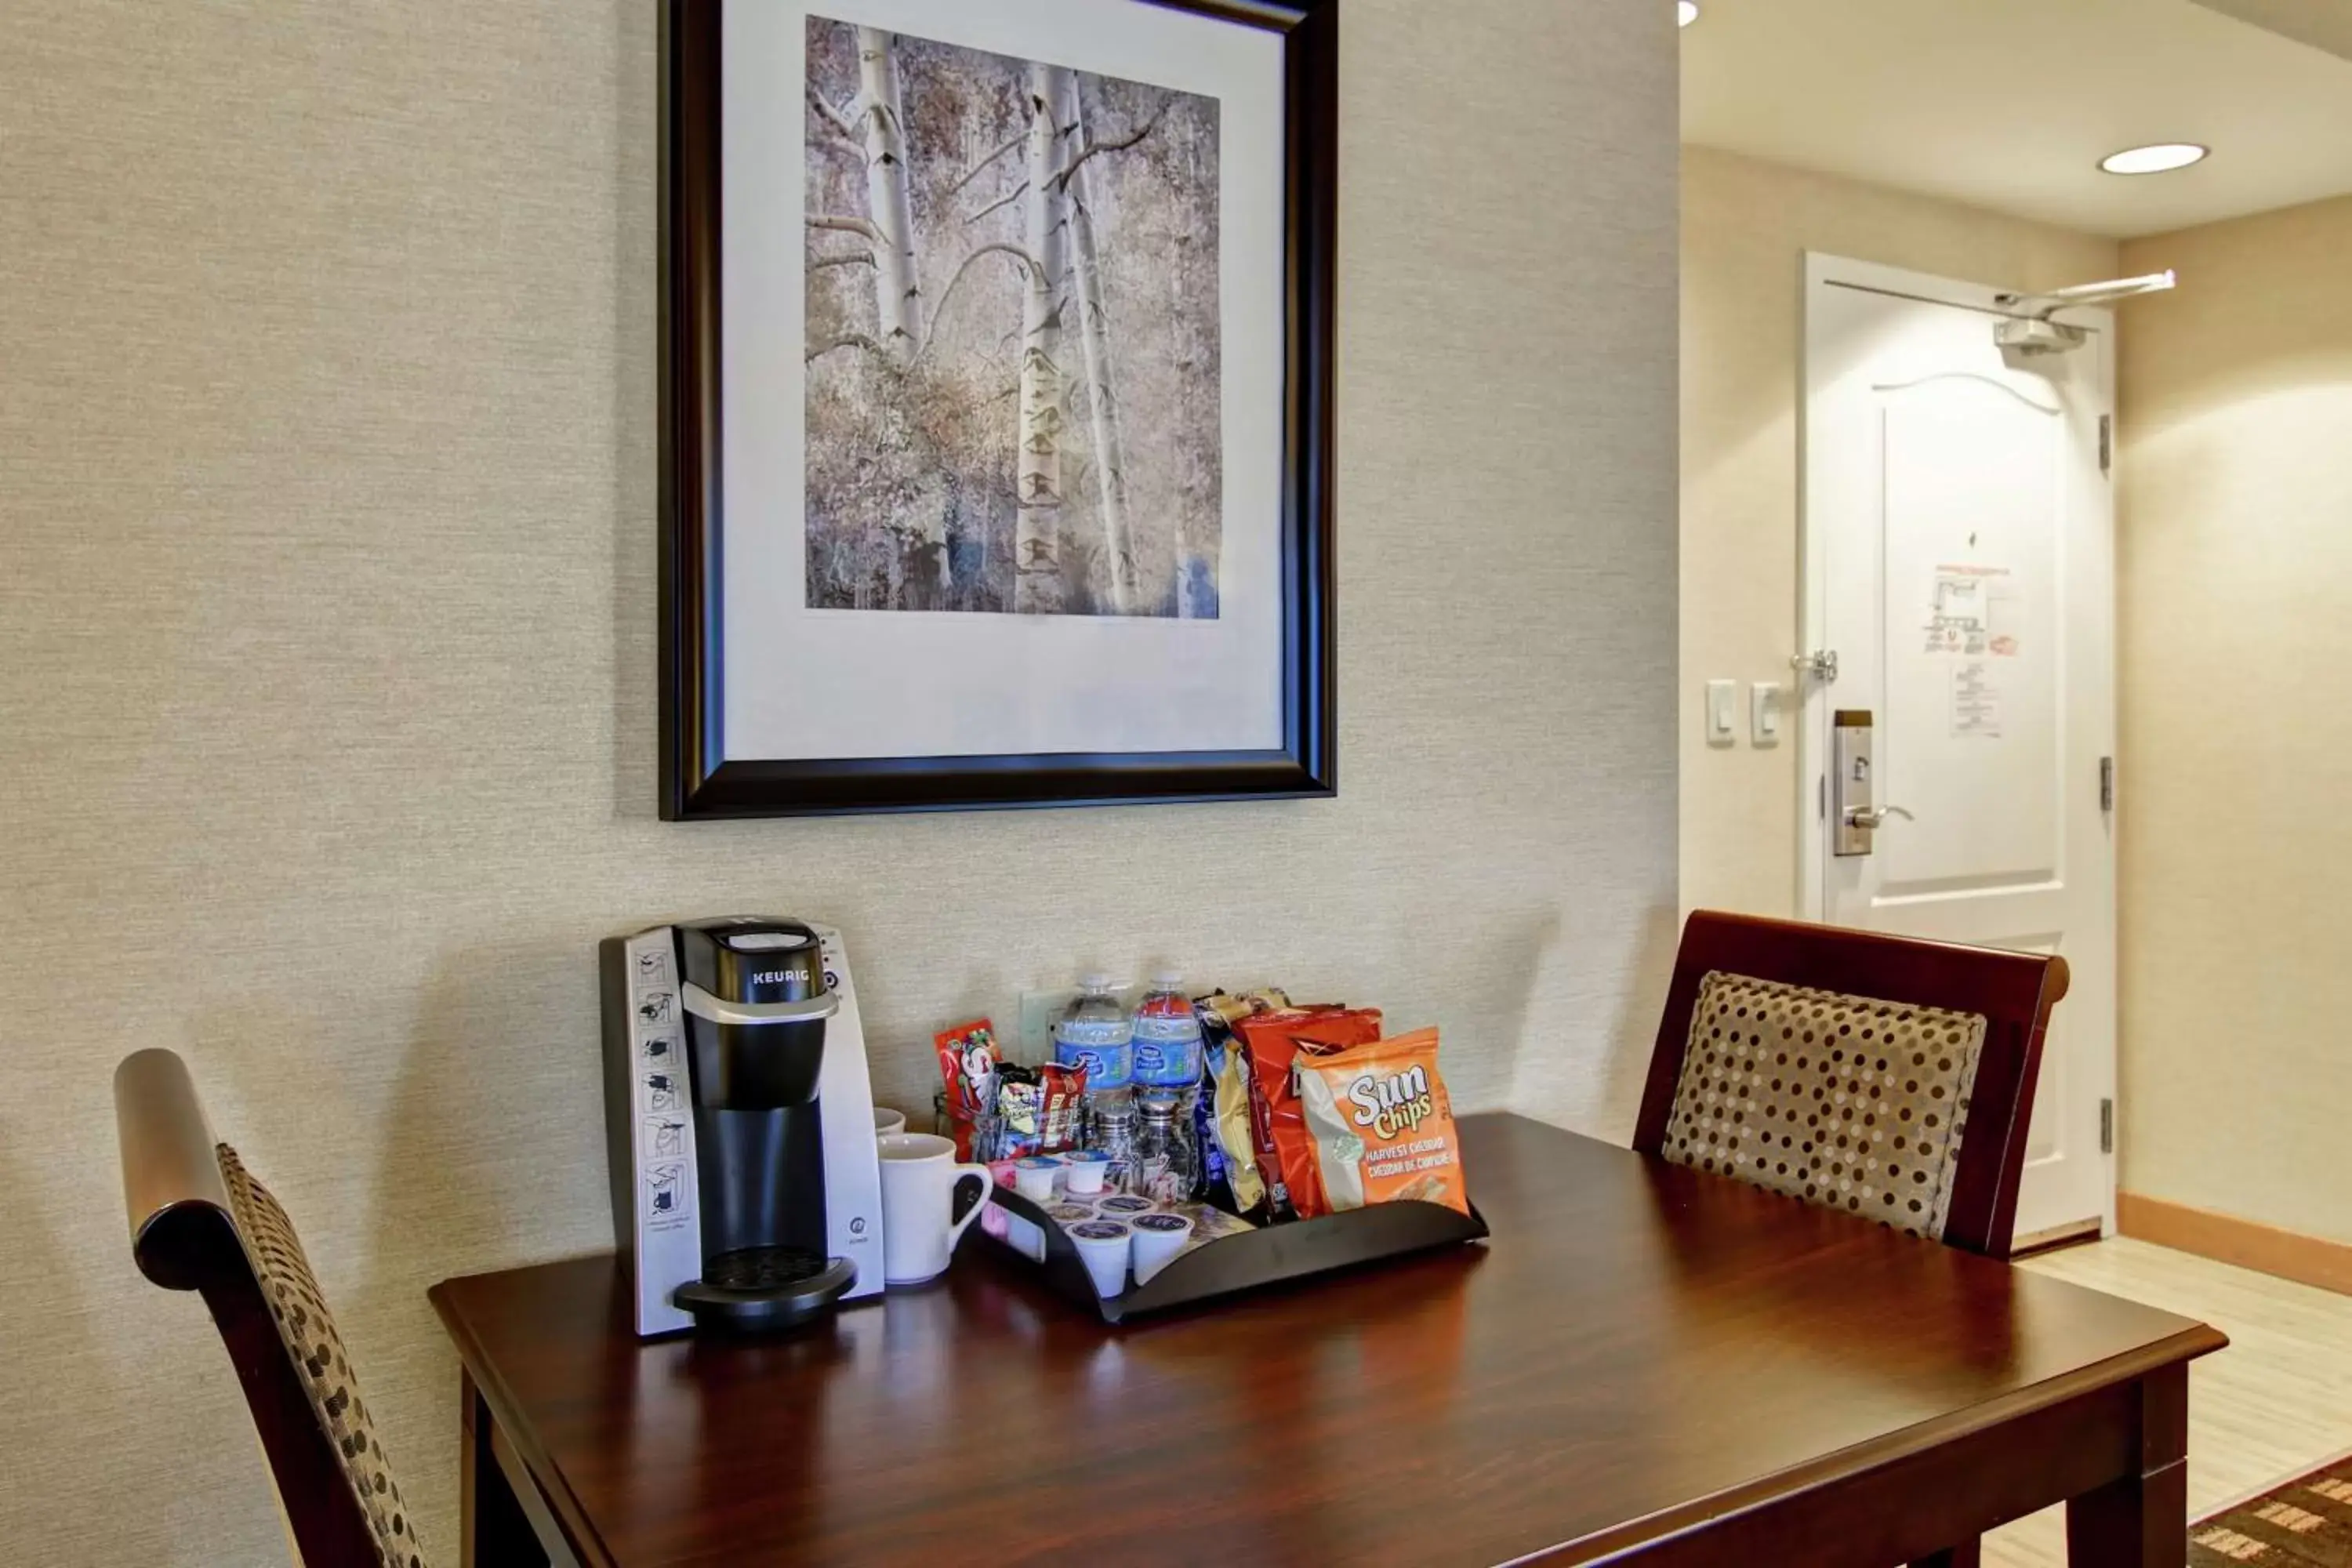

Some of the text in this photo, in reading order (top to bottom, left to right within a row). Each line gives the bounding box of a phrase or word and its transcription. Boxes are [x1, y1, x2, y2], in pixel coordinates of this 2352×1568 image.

[753, 970, 809, 985] KEURIG
[1348, 1065, 1428, 1126] Sun
[1374, 1094, 1432, 1138] Chips
[1367, 1144, 1407, 1161] HARVEST
